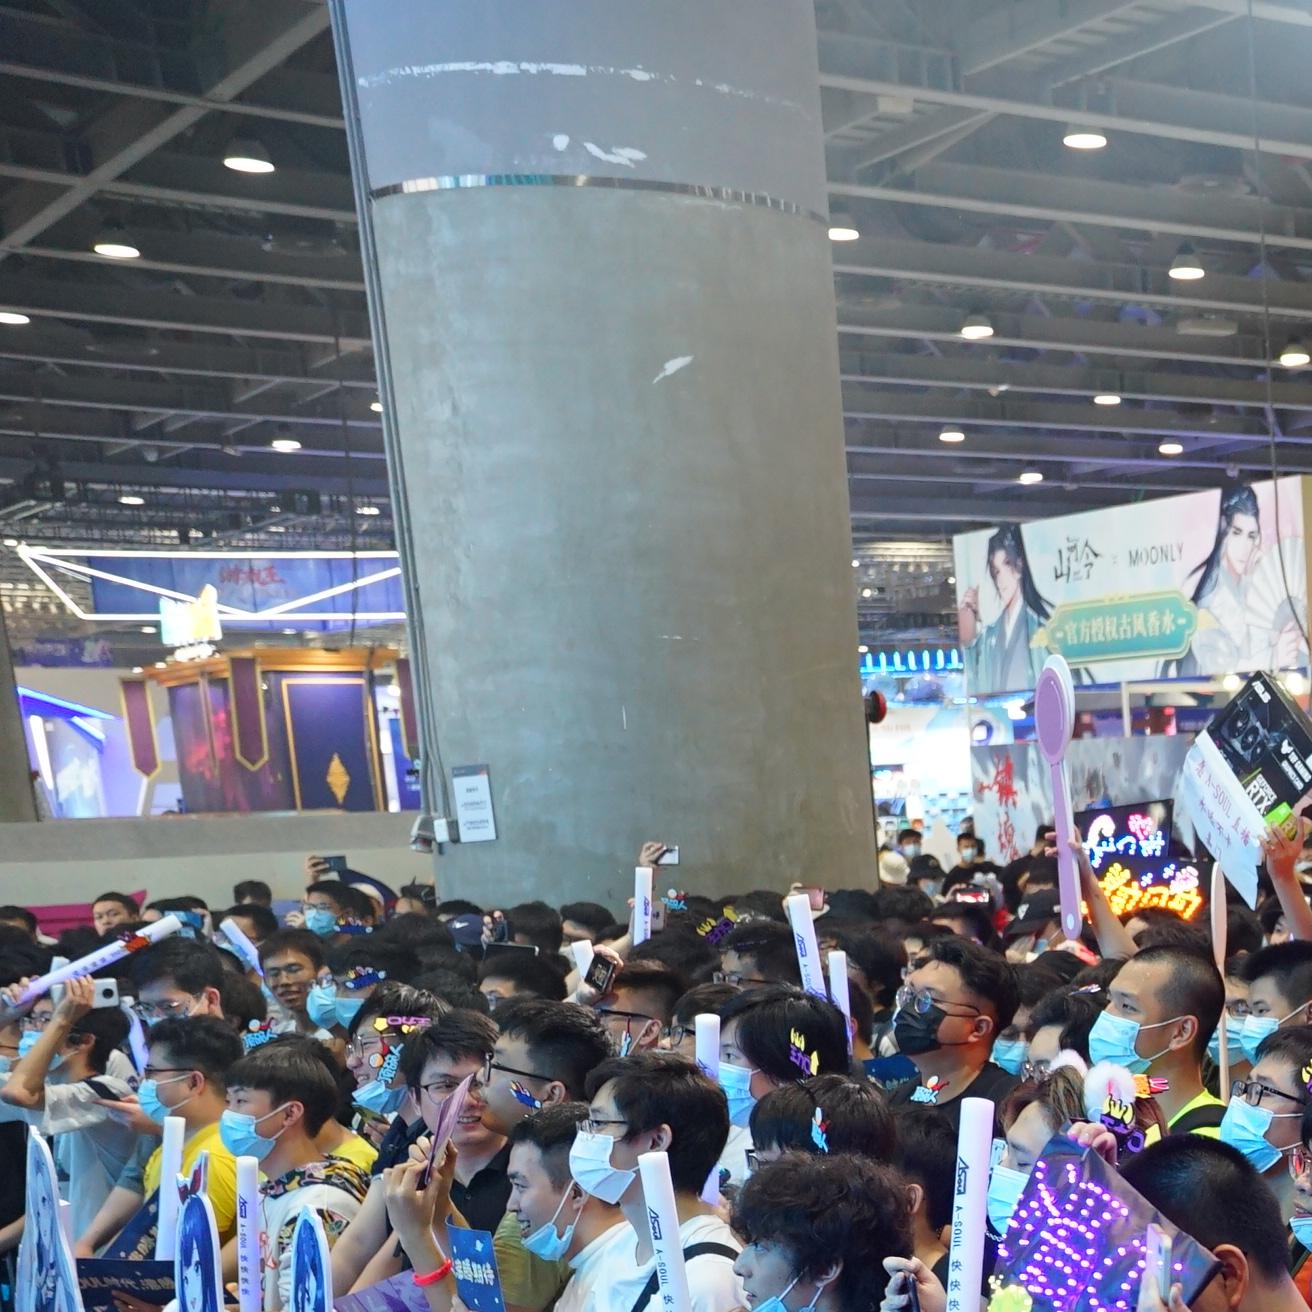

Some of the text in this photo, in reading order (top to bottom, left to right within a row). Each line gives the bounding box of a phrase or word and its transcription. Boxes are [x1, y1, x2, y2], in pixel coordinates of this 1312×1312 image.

[1065, 612, 1176, 645] 官方授权古风香水
[951, 1205, 964, 1248] A-SOUL
[655, 1248, 669, 1286] A-SOUL
